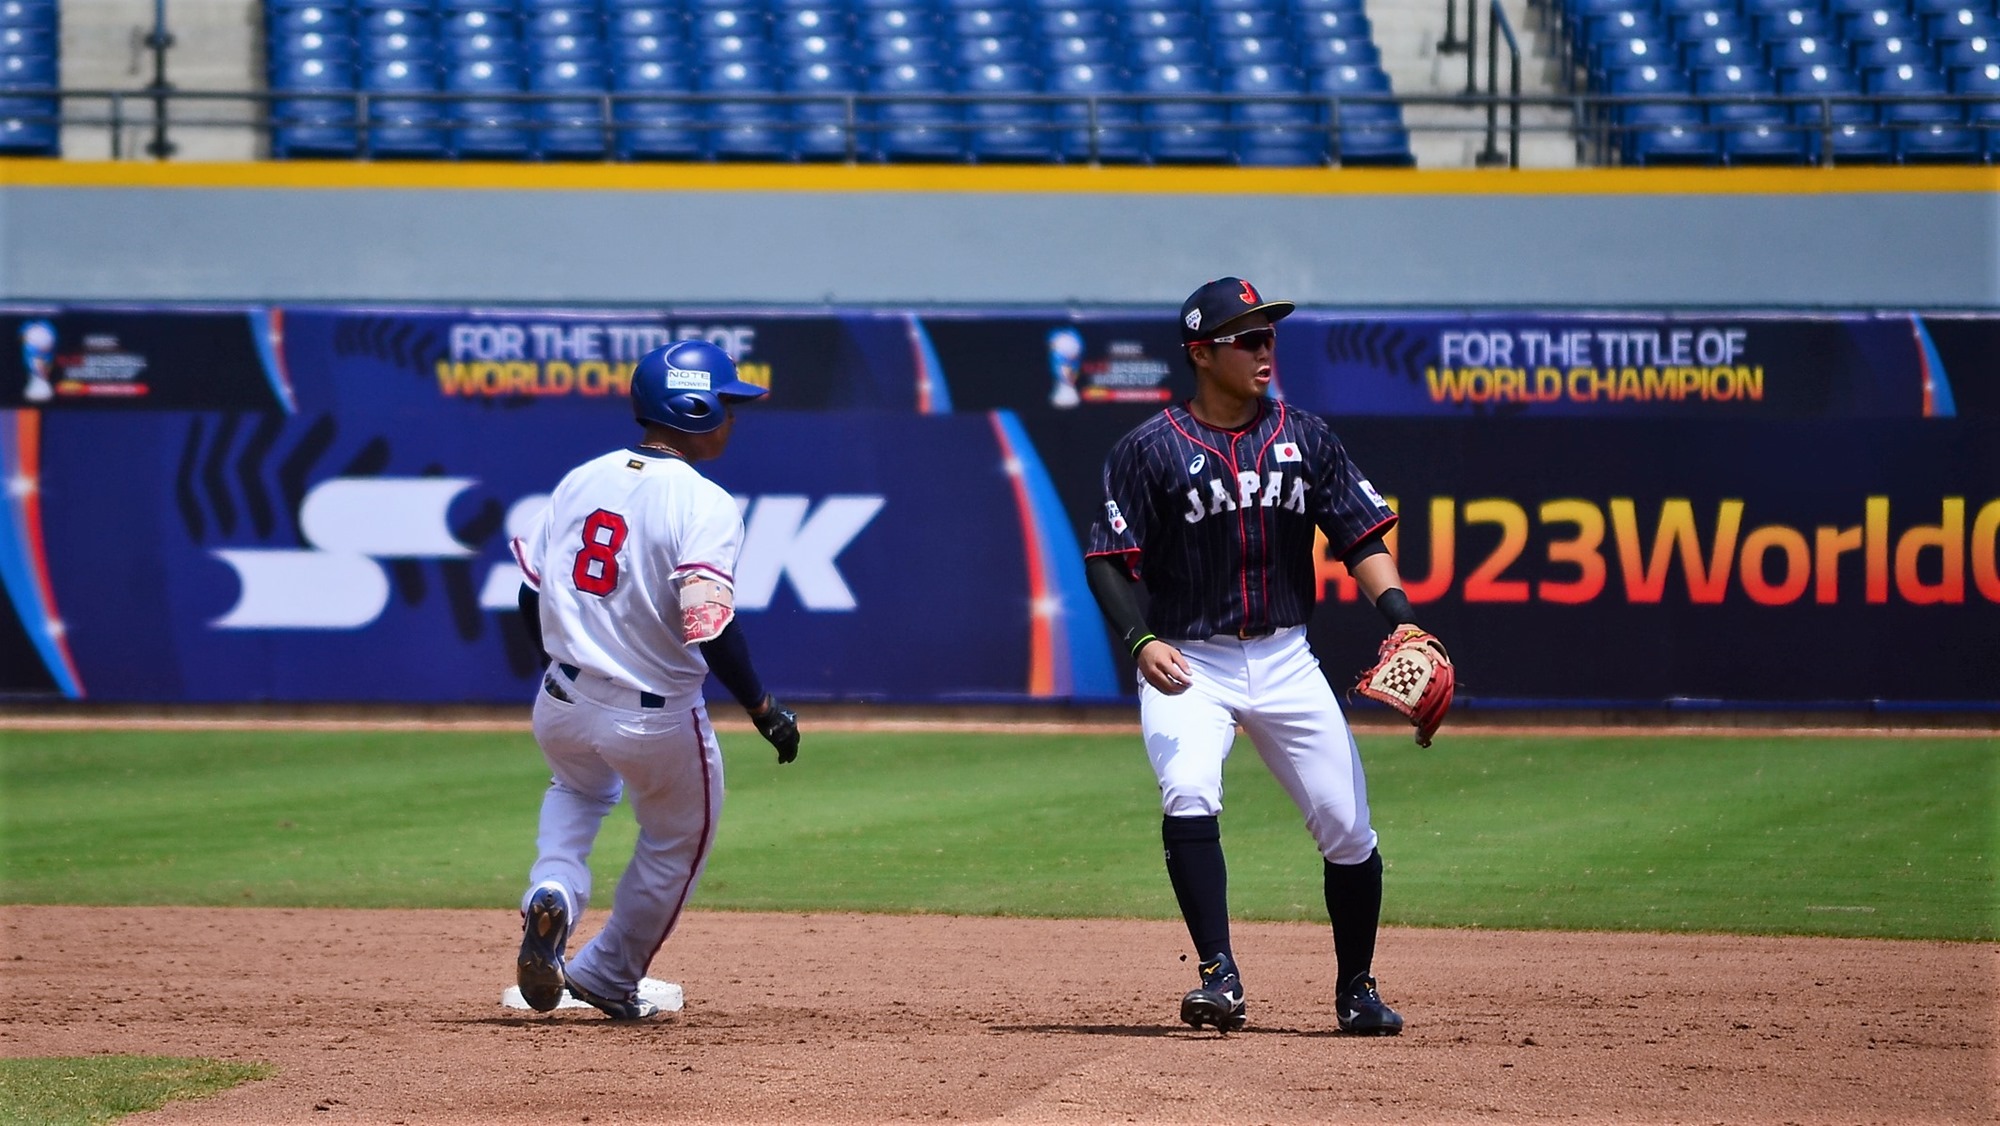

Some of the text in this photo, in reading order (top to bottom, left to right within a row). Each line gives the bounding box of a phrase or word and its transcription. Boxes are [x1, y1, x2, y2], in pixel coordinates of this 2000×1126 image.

[1239, 280, 1257, 304] J
[451, 325, 525, 360] FOR
[530, 325, 603, 360] THE
[1441, 330, 1746, 366] FOR THE TITLE OF
[436, 361, 574, 396] WORLD
[669, 371, 708, 379] NOTE
[1426, 366, 1763, 402] WORLD CHAMPION
[1185, 470, 1312, 523] JAPAN
[572, 508, 628, 598] 8
